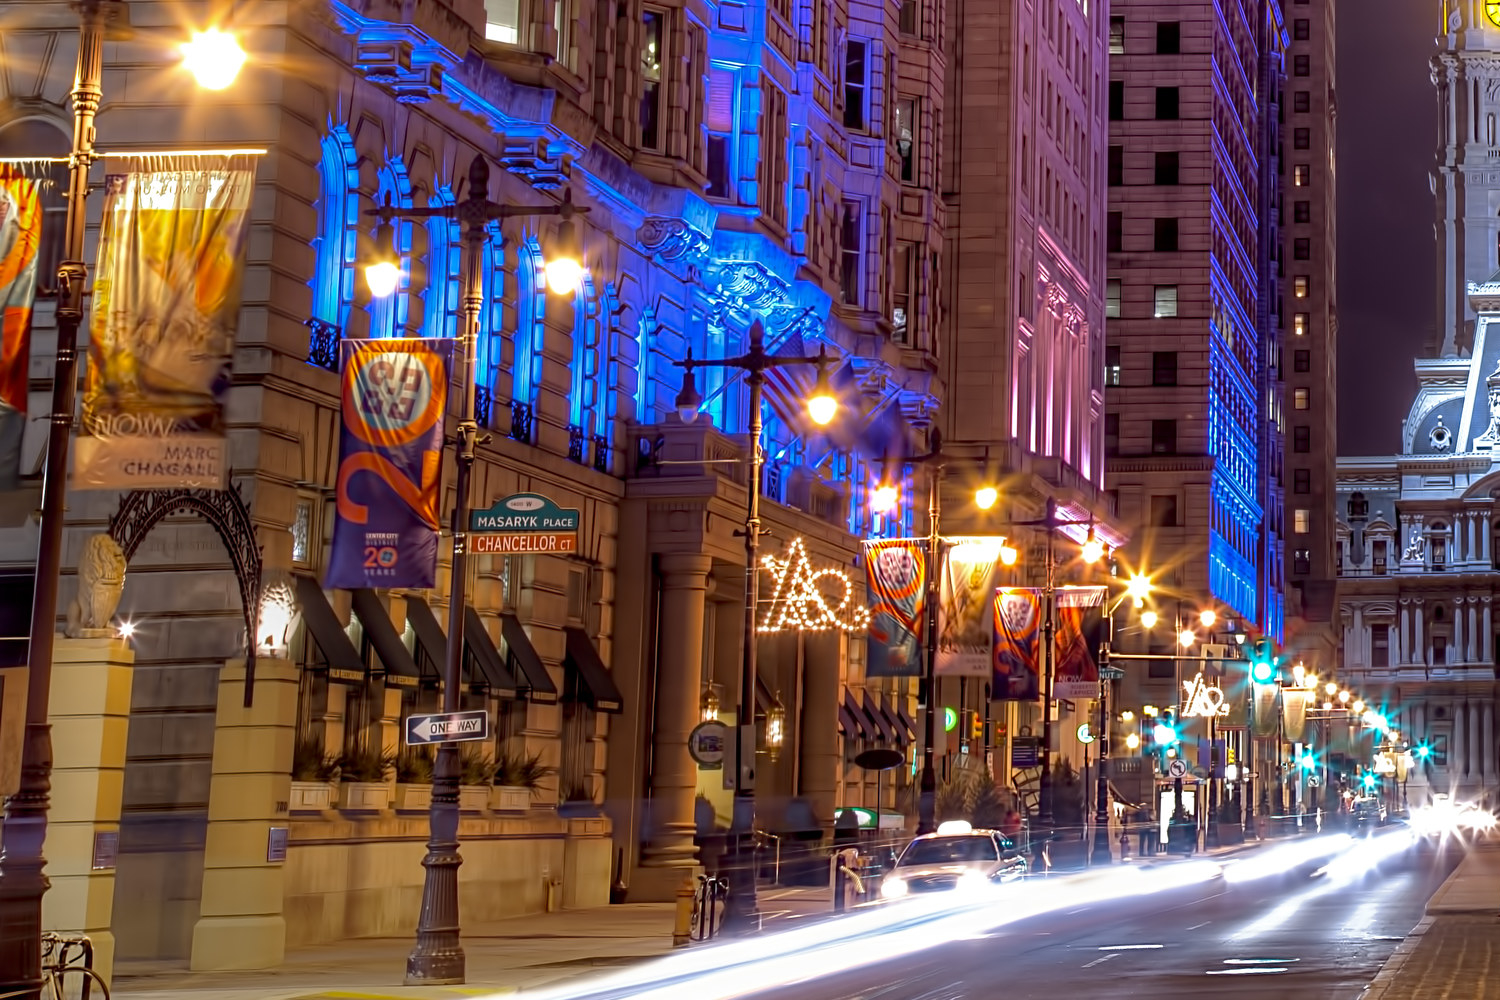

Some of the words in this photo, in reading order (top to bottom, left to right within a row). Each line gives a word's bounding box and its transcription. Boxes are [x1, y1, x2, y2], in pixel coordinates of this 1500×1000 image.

[93, 413, 174, 438] NOW
[163, 446, 218, 461] MARC
[123, 462, 218, 477] CHAGALL
[477, 516, 538, 527] MASARYK
[543, 518, 573, 527] PLACE
[477, 535, 556, 552] CHANCELLOR
[560, 539, 571, 551] CT
[363, 546, 398, 568] 20
[430, 722, 452, 734] ONE
[456, 719, 478, 732] WAY
